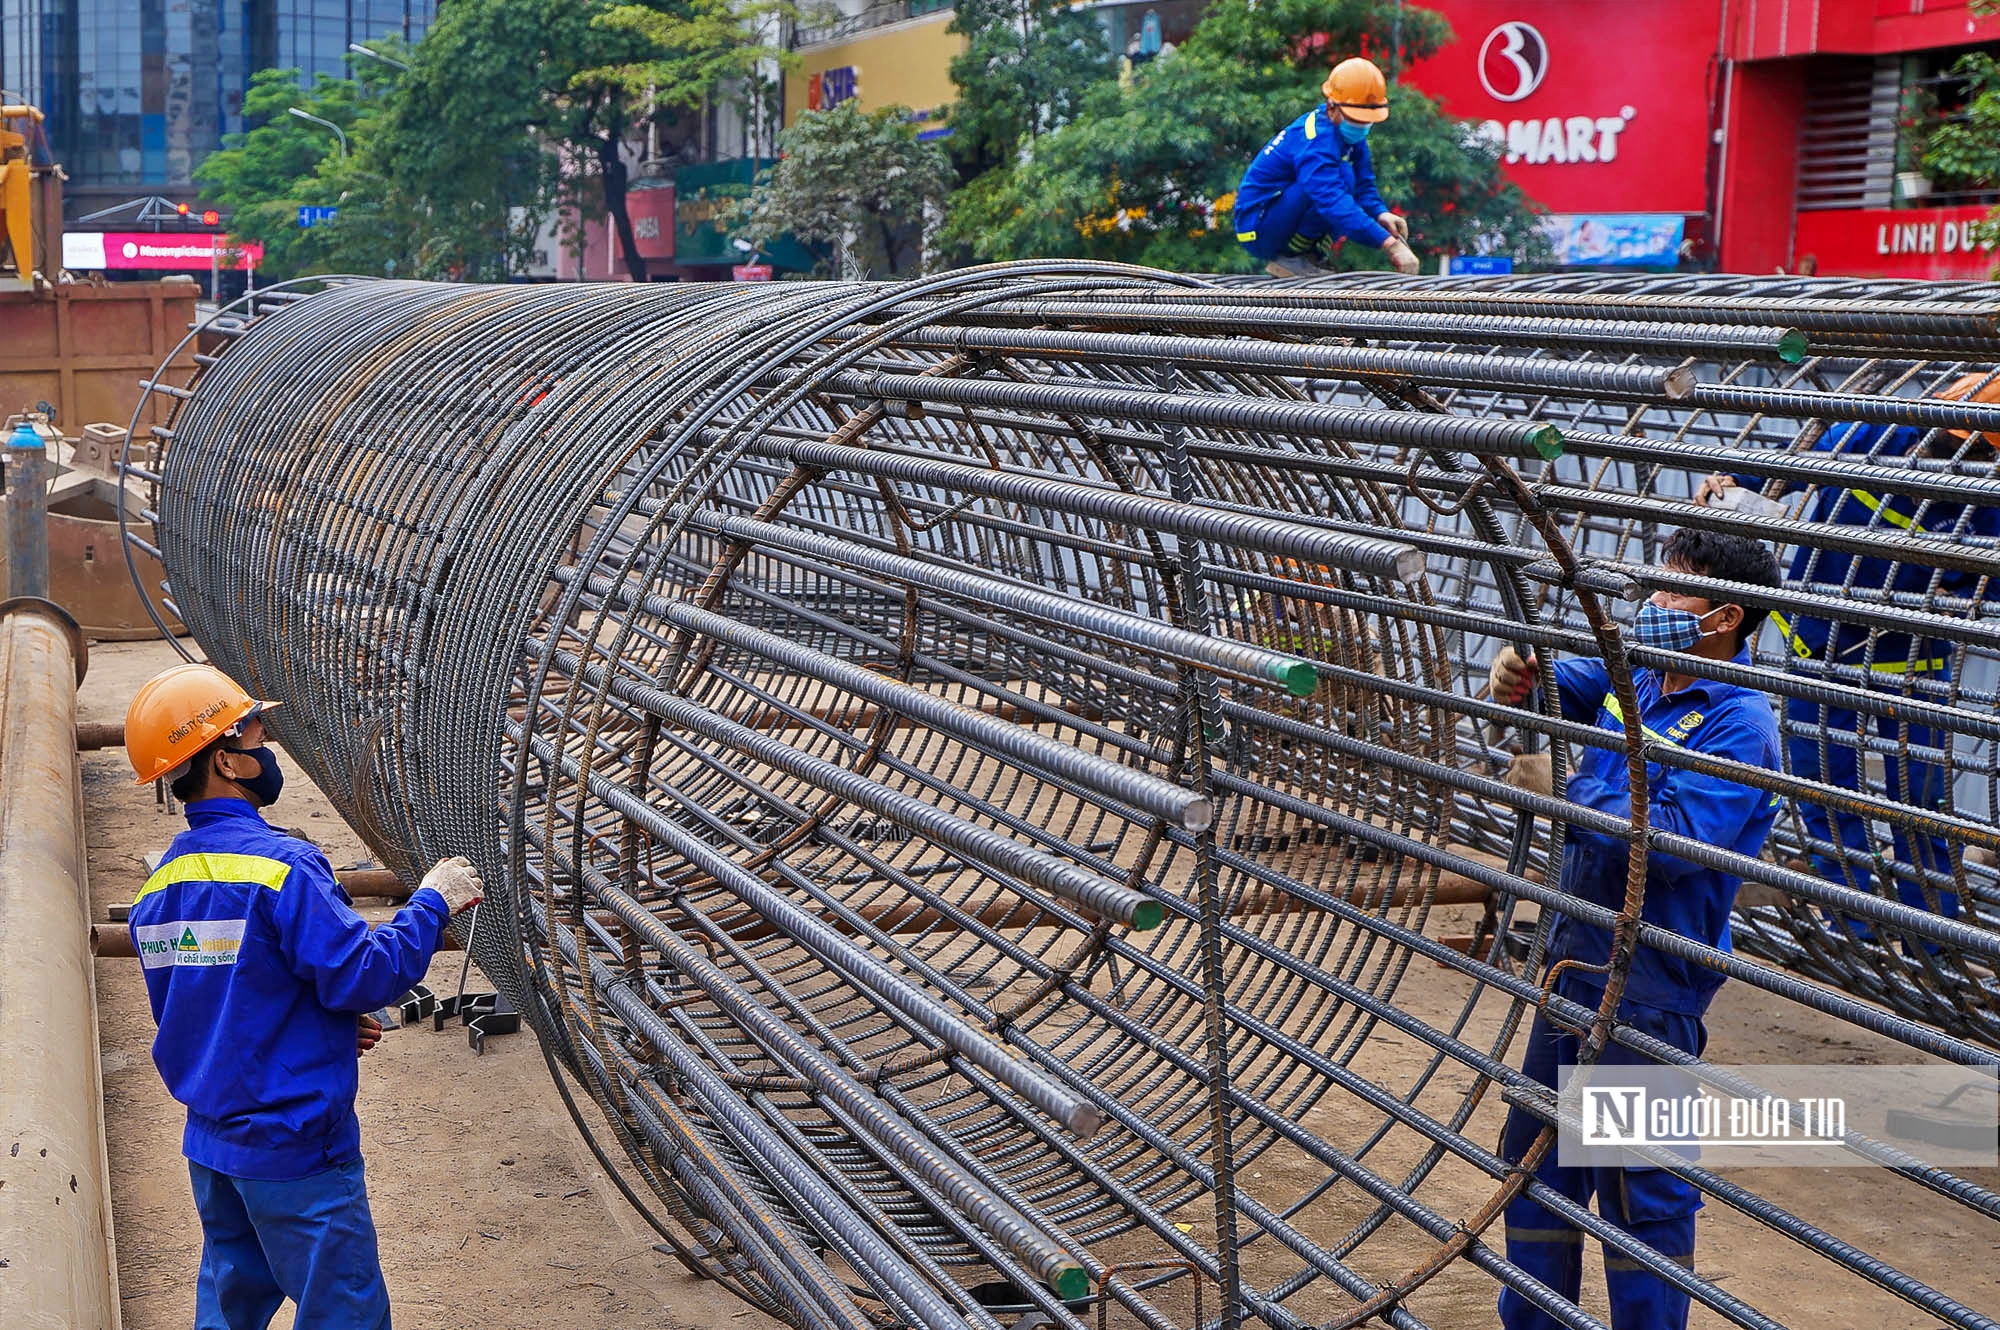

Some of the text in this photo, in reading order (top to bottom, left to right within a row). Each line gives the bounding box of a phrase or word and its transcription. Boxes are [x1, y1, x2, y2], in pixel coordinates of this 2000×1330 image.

[1877, 222, 1937, 255] LINH
[168, 726, 189, 744] CÔNG
[186, 719, 198, 730] TY
[219, 700, 228, 710] 12
